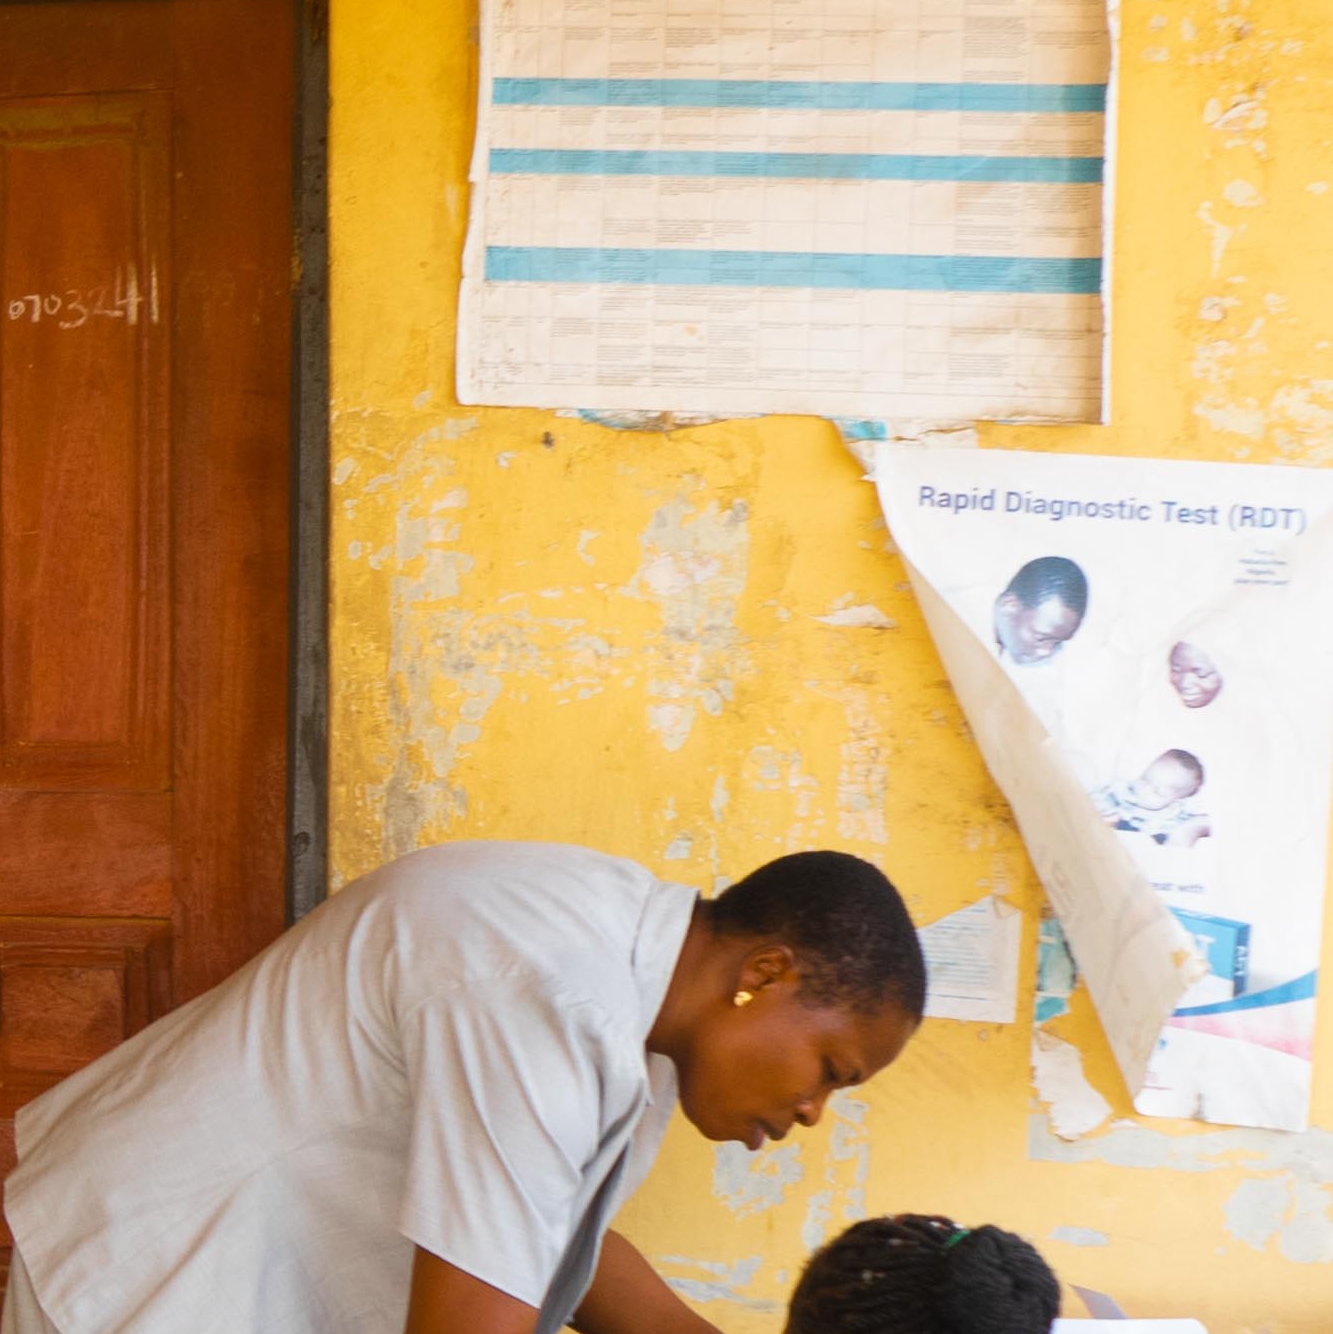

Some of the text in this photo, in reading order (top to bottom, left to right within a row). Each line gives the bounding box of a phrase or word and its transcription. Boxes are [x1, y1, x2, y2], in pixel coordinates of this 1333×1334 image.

[919, 485, 1308, 536] Rapid Diagnostic Test (RDT)
